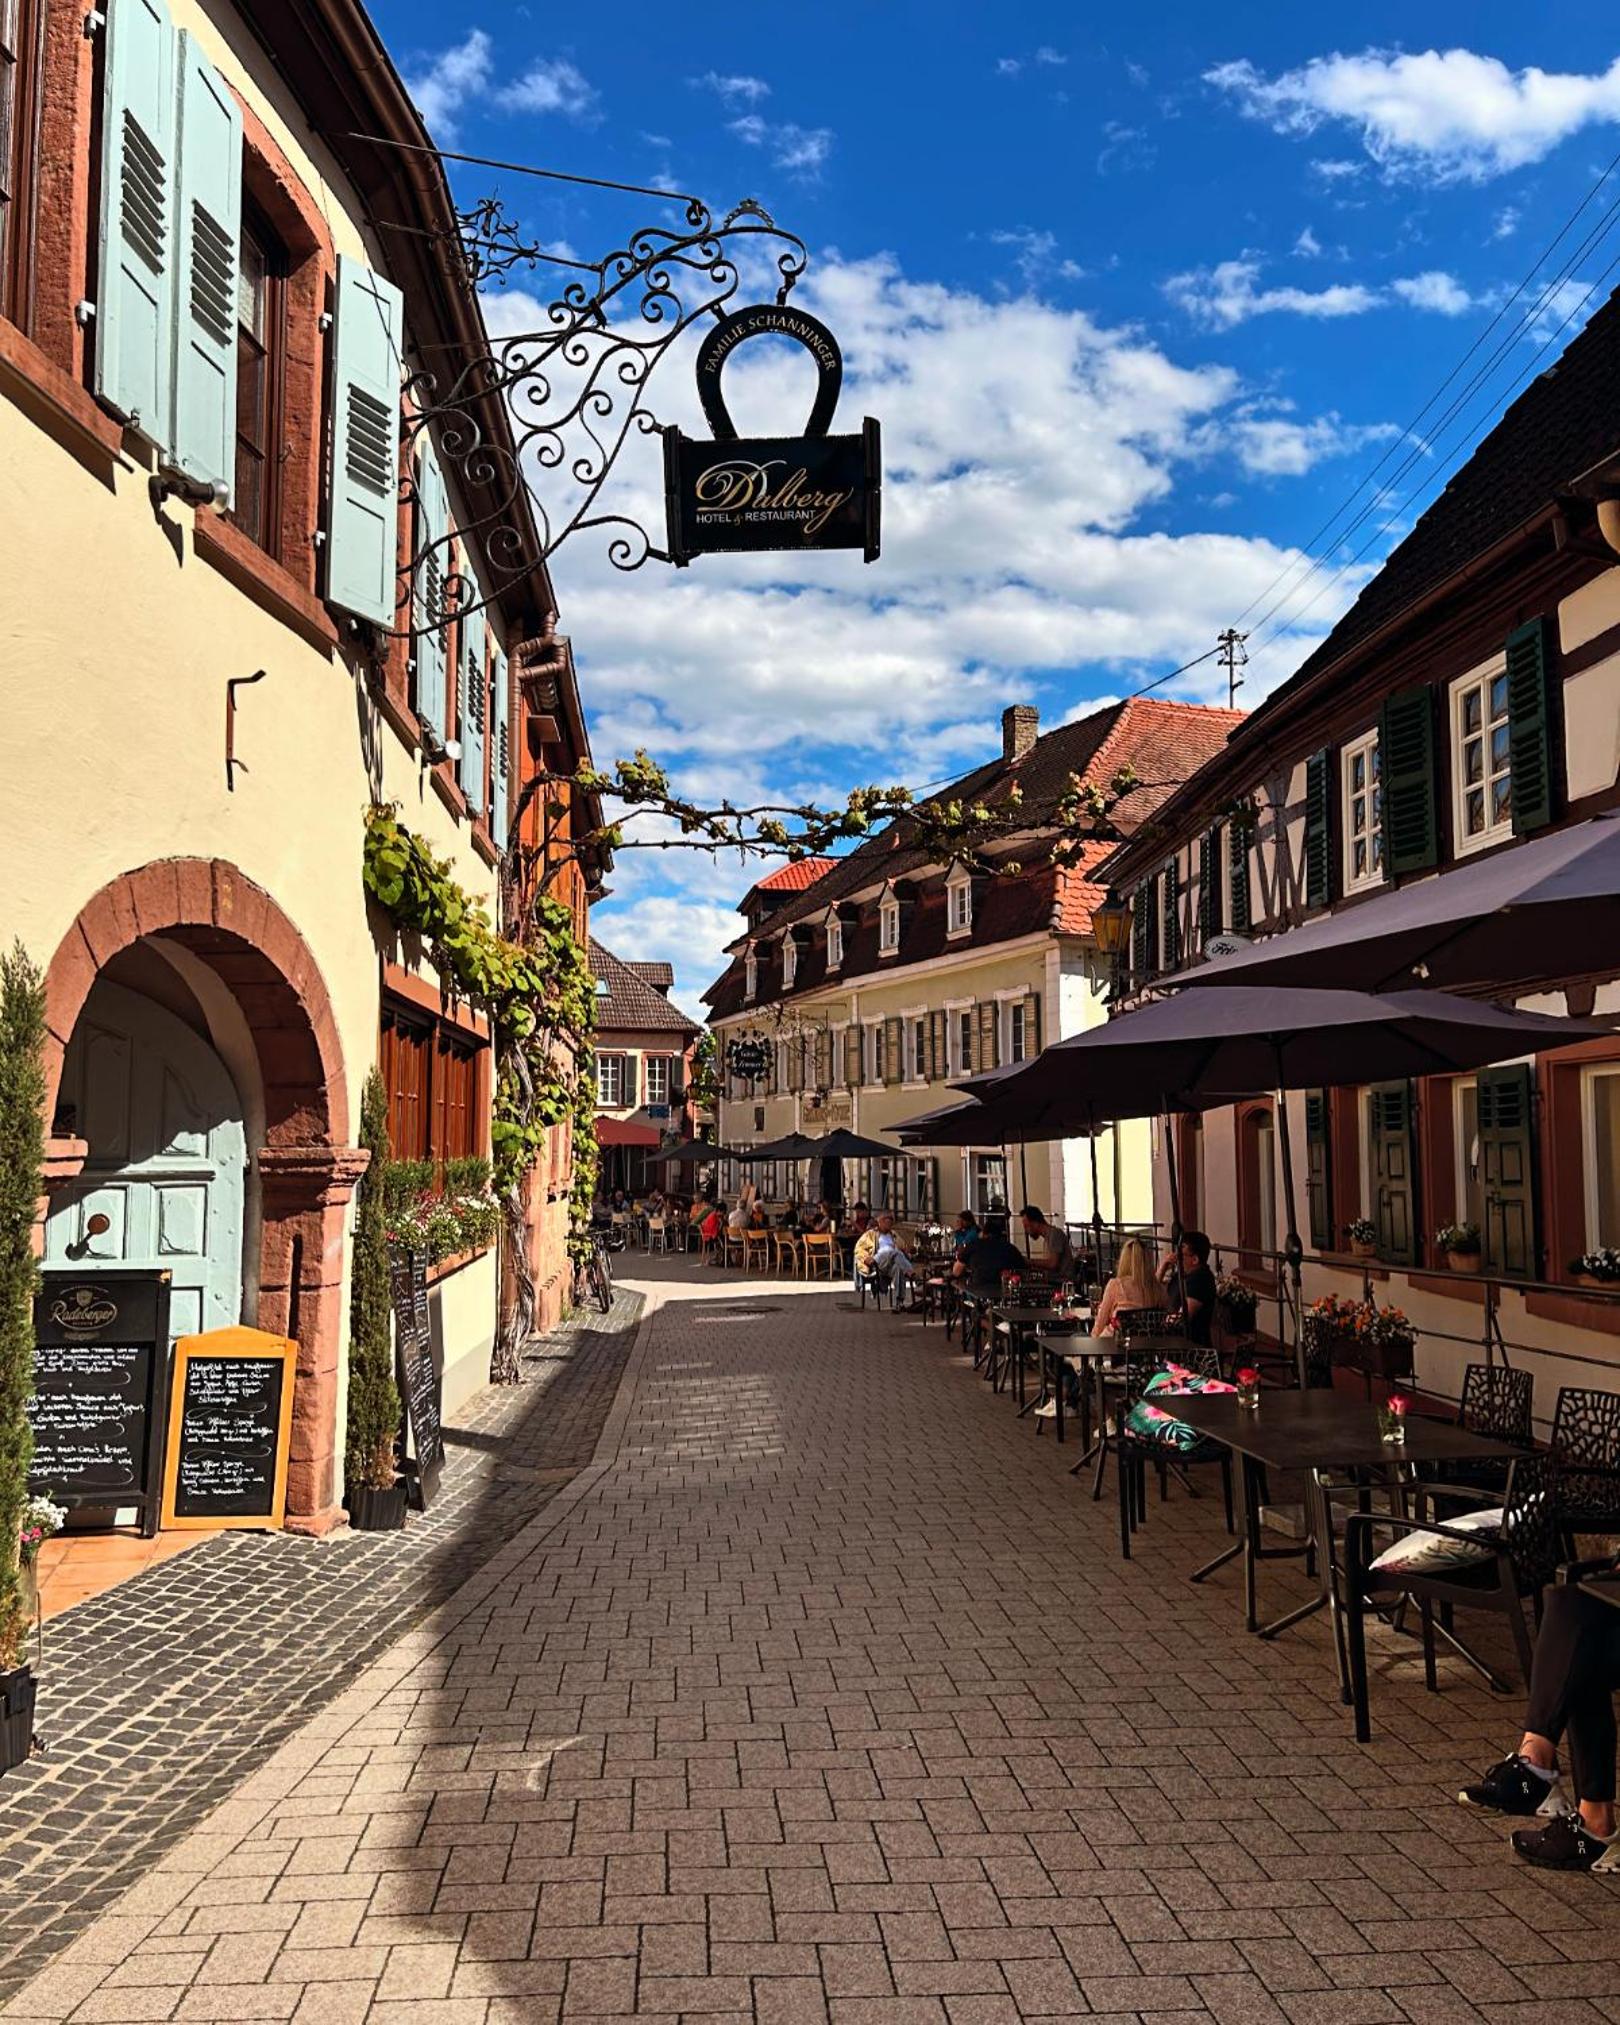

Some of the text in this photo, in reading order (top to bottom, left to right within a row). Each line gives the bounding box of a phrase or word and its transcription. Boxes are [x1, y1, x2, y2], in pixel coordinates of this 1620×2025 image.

[705, 314, 837, 373] FAMILIE SCHANNINGER
[695, 459, 854, 534] Dalberg
[696, 513, 732, 524] HOTEL
[745, 509, 817, 521] RESTAURANT
[48, 1300, 114, 1324] Radeberger
